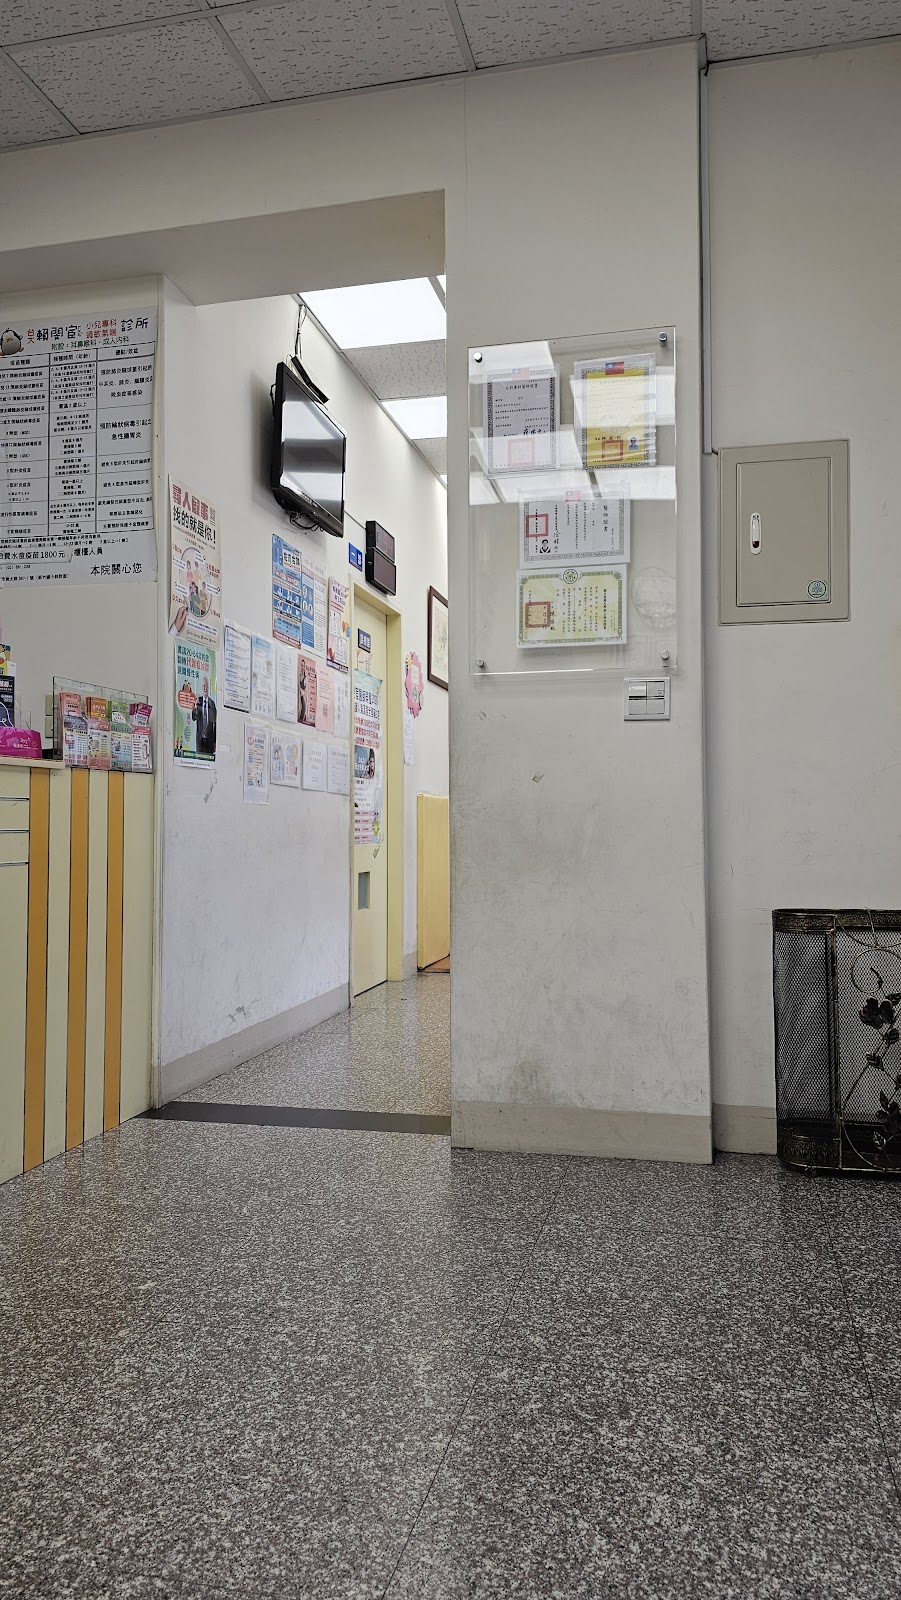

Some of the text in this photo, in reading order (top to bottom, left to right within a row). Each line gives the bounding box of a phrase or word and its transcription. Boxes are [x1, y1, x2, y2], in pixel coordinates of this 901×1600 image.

[86, 318, 117, 330] 小兒專科
[120, 317, 149, 332] 診所
[90, 562, 142, 576] 本院關心您
